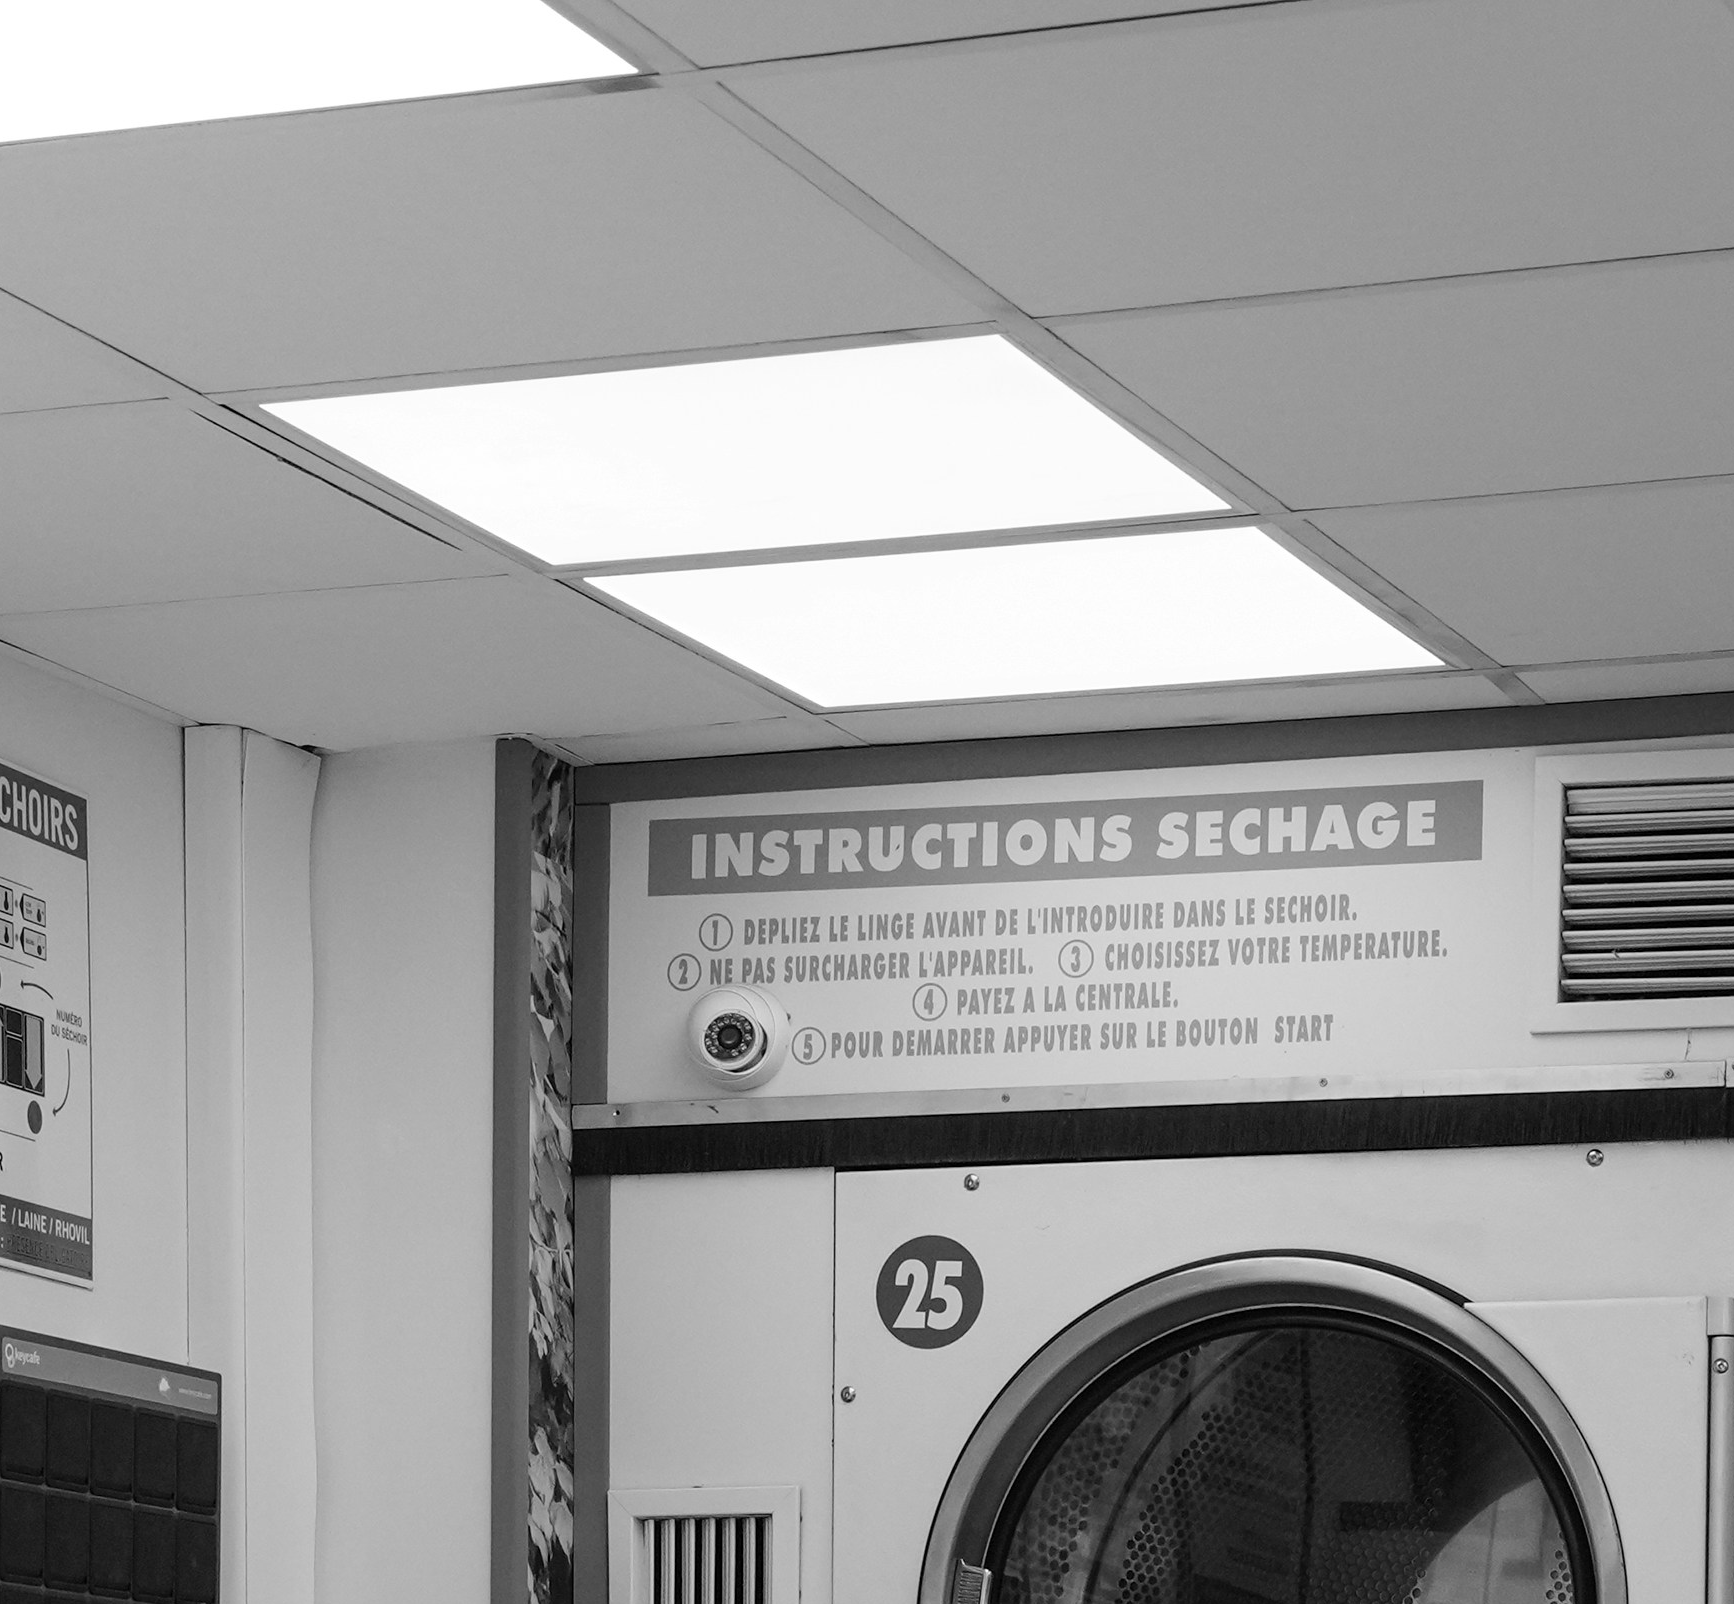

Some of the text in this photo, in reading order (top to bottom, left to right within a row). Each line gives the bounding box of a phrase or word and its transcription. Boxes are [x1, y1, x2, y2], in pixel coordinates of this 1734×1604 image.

[691, 800, 1436, 879] INSTRUCTIONS SECHAGE
[744, 916, 821, 945] DEPLIEZ
[829, 915, 848, 942] LE
[857, 912, 914, 941] LINGE
[922, 910, 986, 939] AVANT
[995, 908, 1018, 936] DE
[1027, 902, 1164, 935] L'INTRODUIRE
[1173, 899, 1225, 928] DANS
[1235, 897, 1255, 926] LE
[1264, 894, 1357, 925] SECHOIR.
[957, 987, 1015, 1015] PAYEZ
[1022, 986, 1035, 1013] A
[1044, 985, 1066, 1012] LA
[1075, 981, 1178, 1012] CENTRALE.
[51, 1024, 87, 1046] DU SÉCHOIR
[56, 1009, 82, 1028] NUMÉRO
[18, 1209, 46, 1233] LAINE
[55, 1219, 89, 1245] RHOVIL
[893, 1259, 964, 1331] 25
[15, 1347, 40, 1364] keycafe
